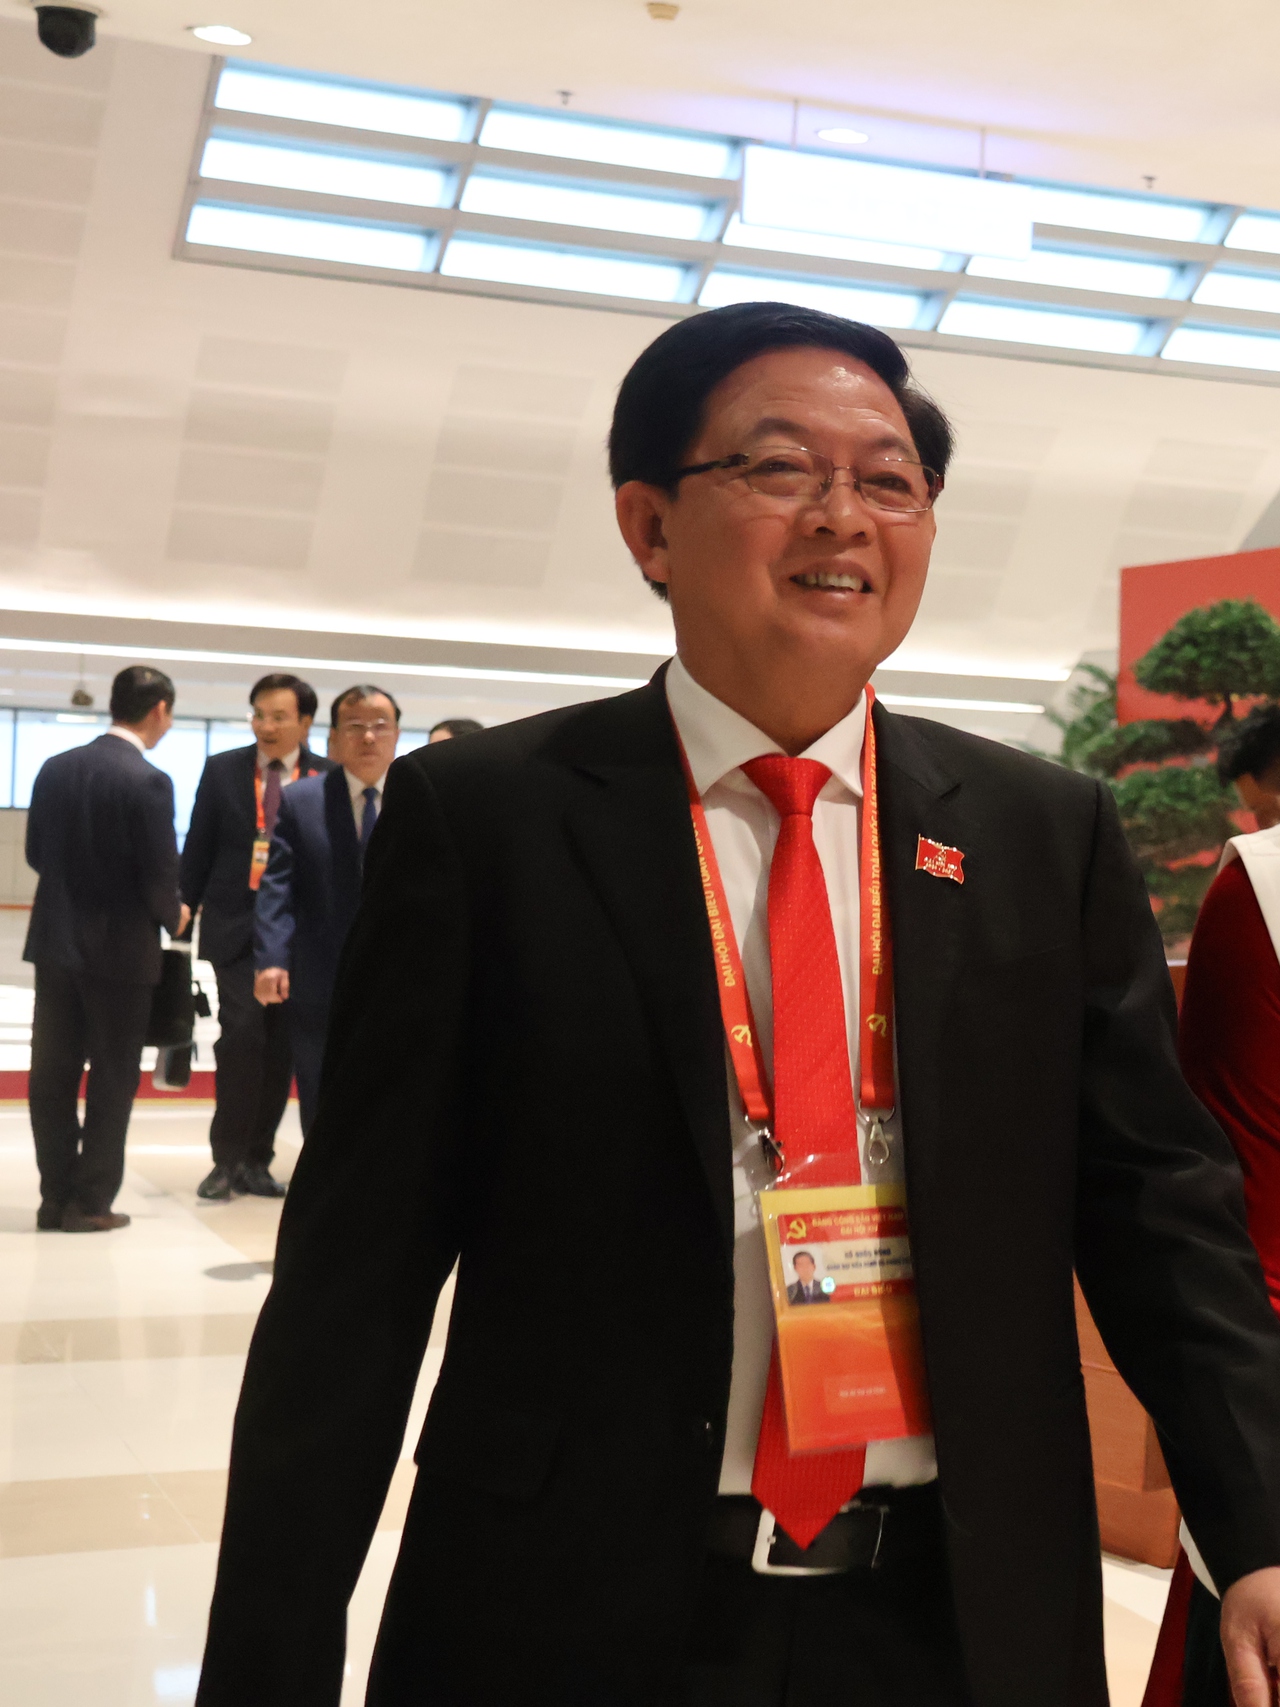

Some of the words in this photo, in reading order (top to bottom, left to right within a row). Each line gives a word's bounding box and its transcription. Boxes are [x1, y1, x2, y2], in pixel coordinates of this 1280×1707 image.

[709, 918, 725, 940] ĐẠI
[715, 941, 731, 963] HỘI
[722, 965, 737, 987] ĐẠI
